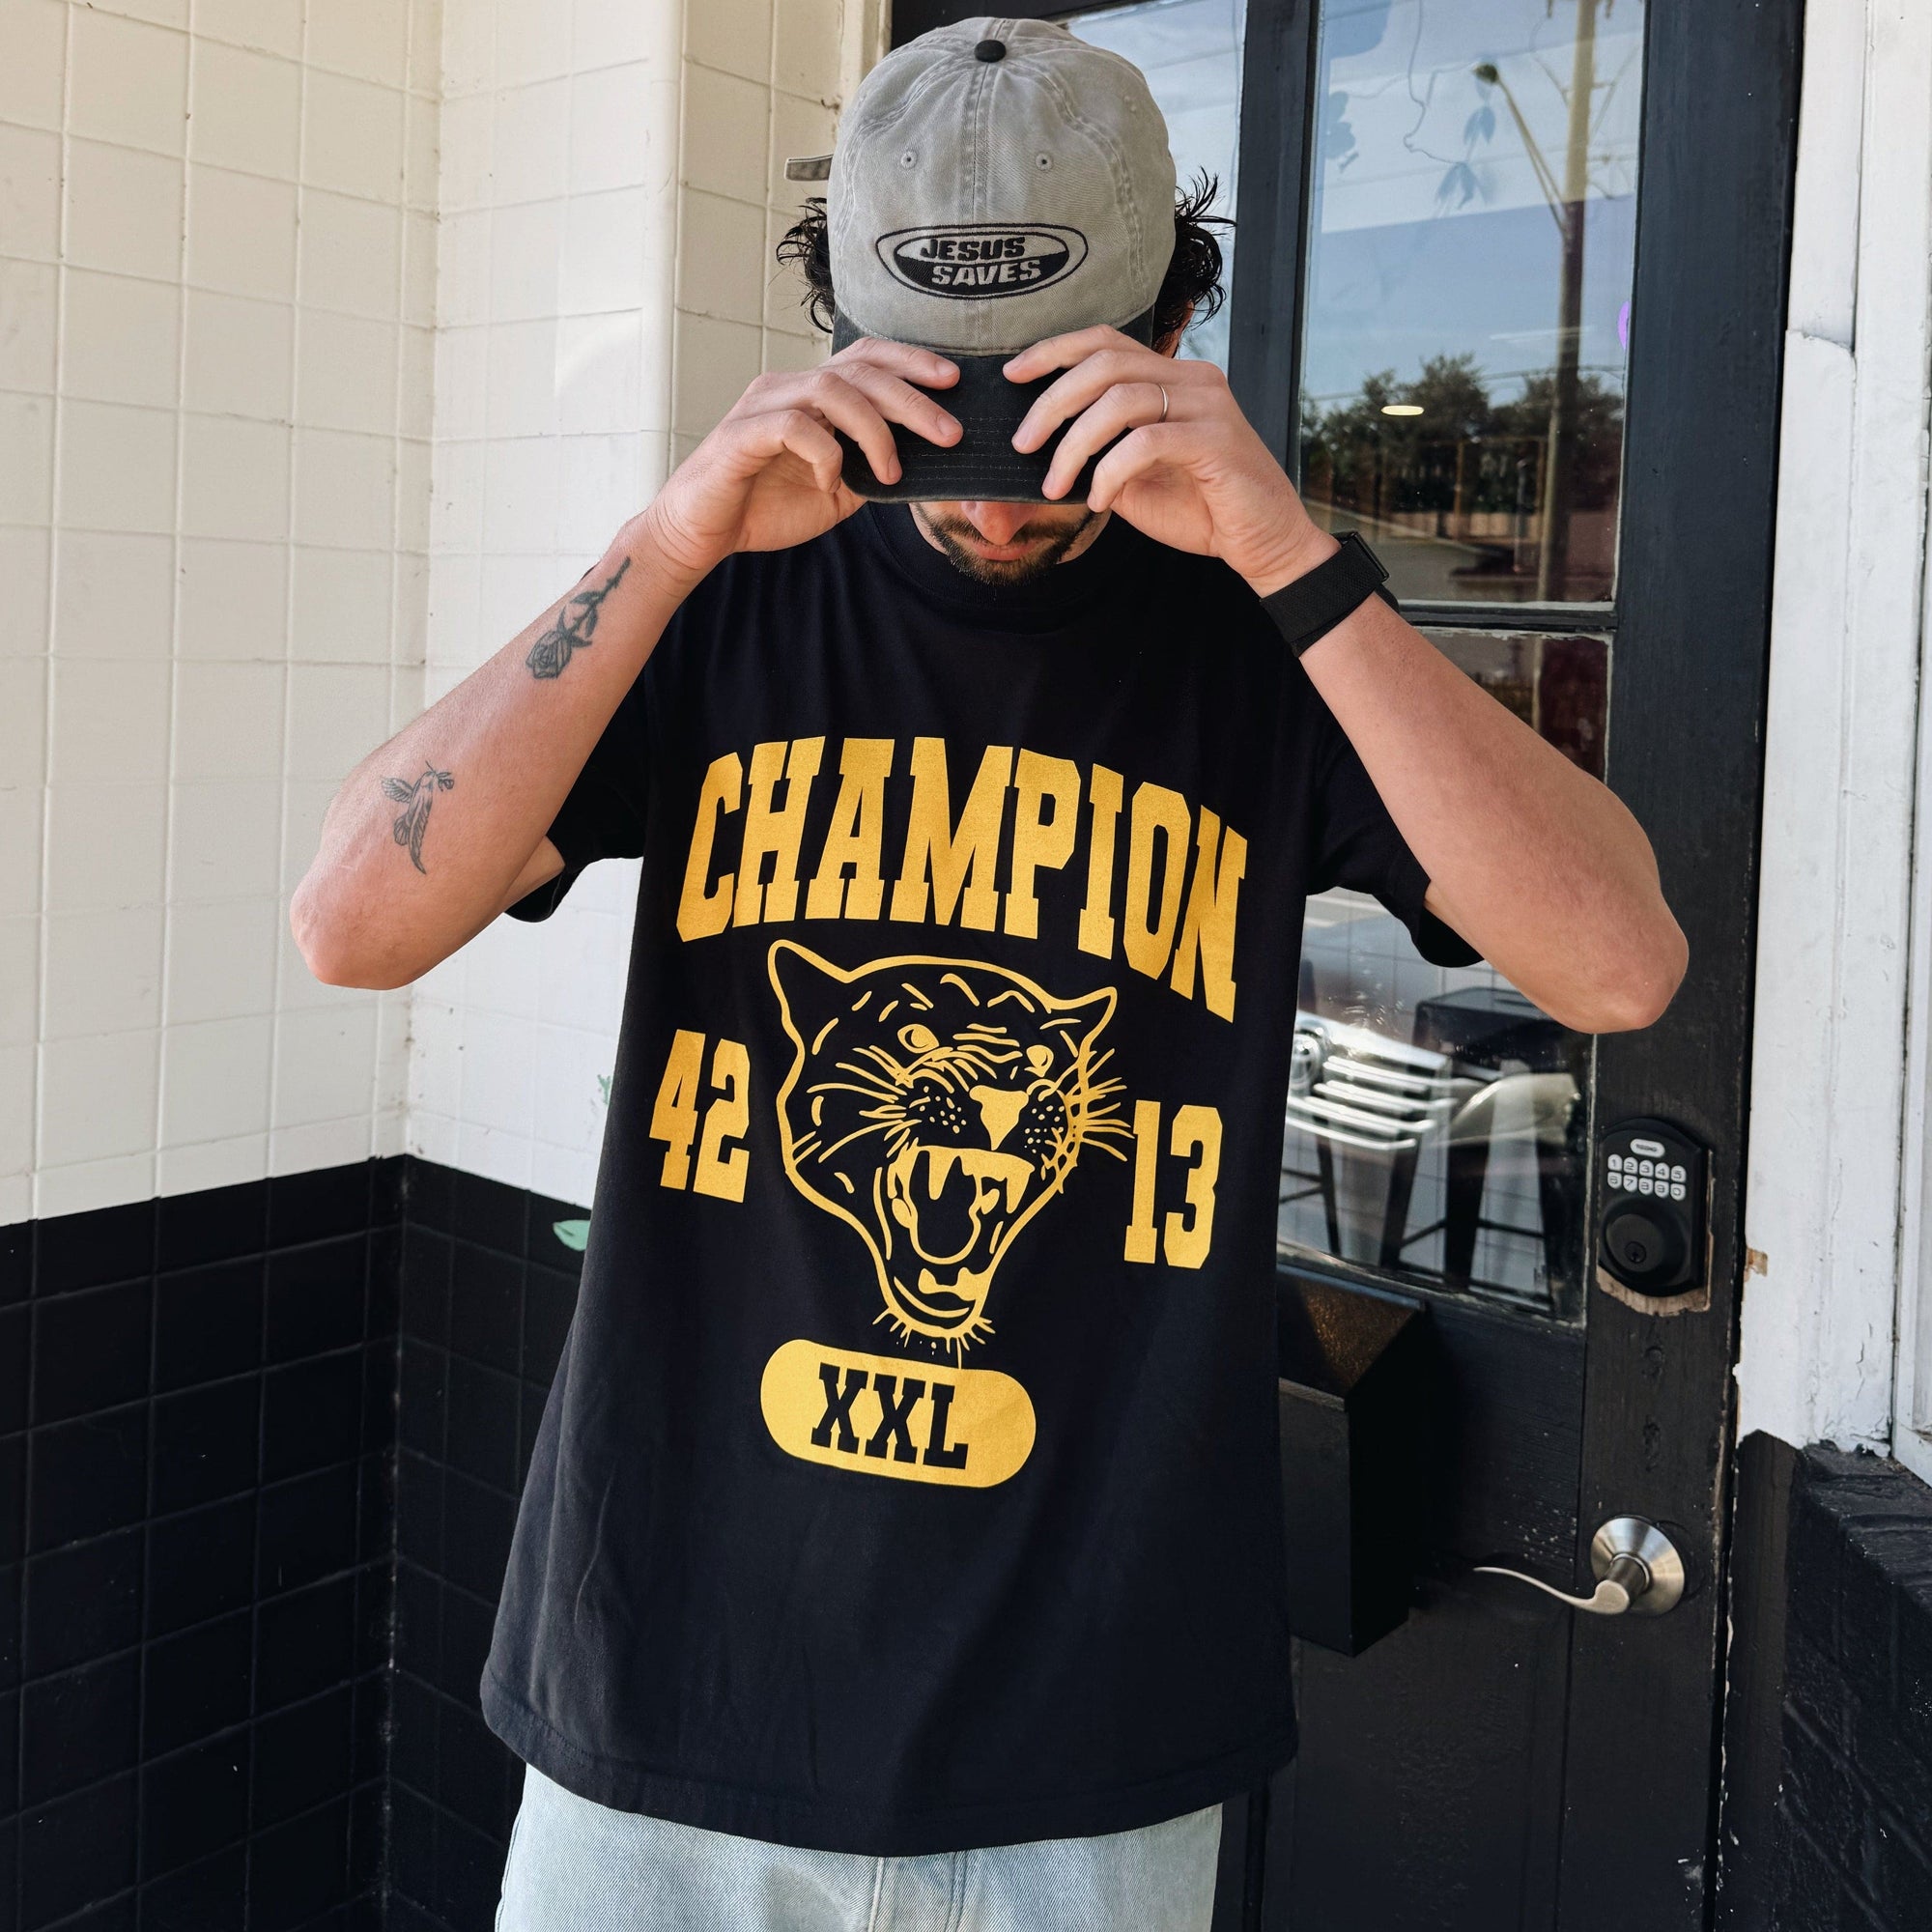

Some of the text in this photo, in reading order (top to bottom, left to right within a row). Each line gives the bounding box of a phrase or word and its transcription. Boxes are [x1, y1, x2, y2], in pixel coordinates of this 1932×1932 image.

[920, 236, 1026, 261] JESUS
[931, 260, 1042, 286] SAVES
[675, 735, 1248, 1024] CHAMPION
[648, 1029, 751, 1203] 42
[1123, 1099, 1224, 1270] 13
[1626, 1161, 1634, 1171] 2
[1641, 1164, 1650, 1174] 3
[1658, 1168, 1665, 1177] 4
[1673, 1170, 1683, 1179] 5
[1626, 1179, 1634, 1187] 7
[810, 1363, 969, 1469] XXL
